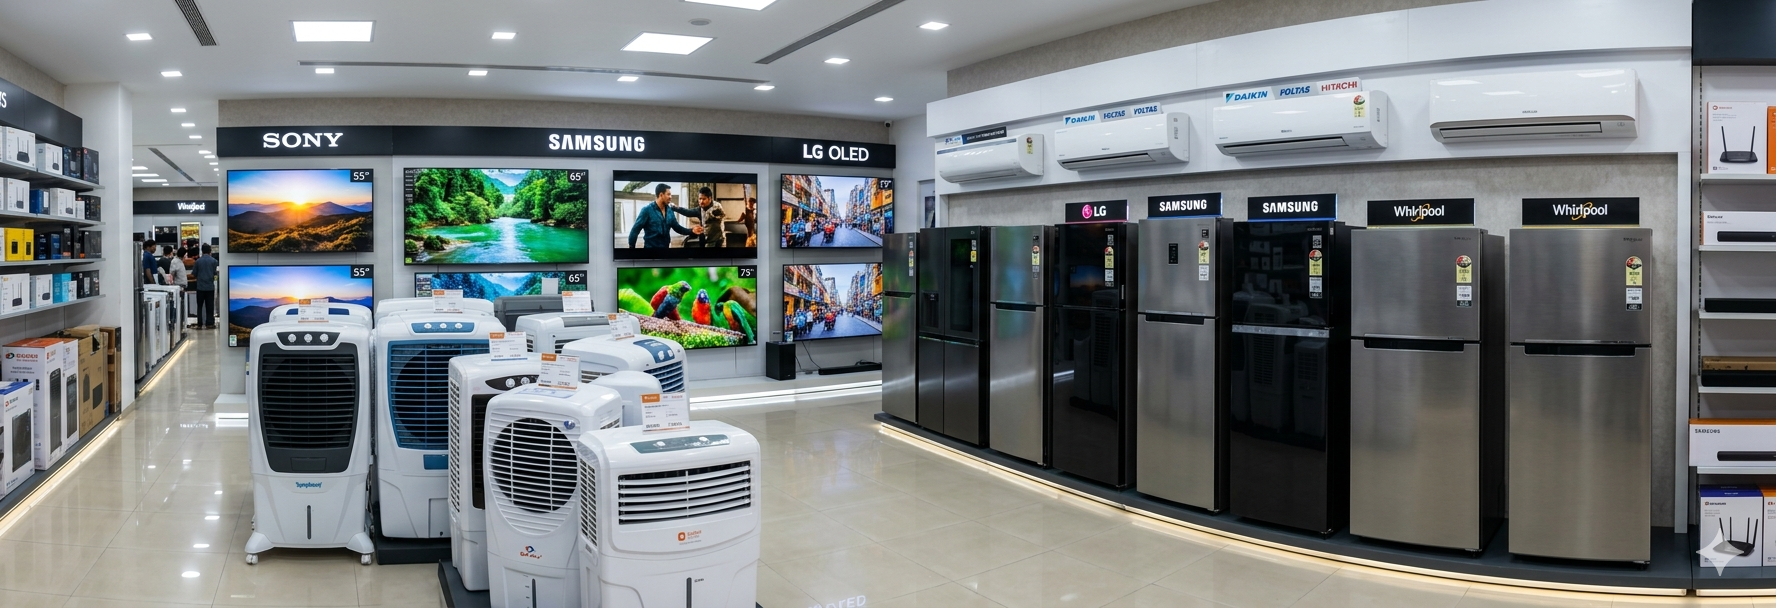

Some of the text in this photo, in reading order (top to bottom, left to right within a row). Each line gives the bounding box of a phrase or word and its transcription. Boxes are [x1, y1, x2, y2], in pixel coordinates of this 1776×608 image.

[1321, 81, 1358, 92] HITACHI
[1234, 90, 1268, 101] DAIKIN
[263, 132, 343, 148] SONY
[548, 133, 645, 152] SAMSUNG
[803, 143, 869, 161] LG OLED
[1094, 206, 1107, 217] LG
[1159, 199, 1208, 212] SAMSUNG
[1262, 201, 1319, 213] SAMSUNG
[1553, 203, 1608, 218] Whirlpool
